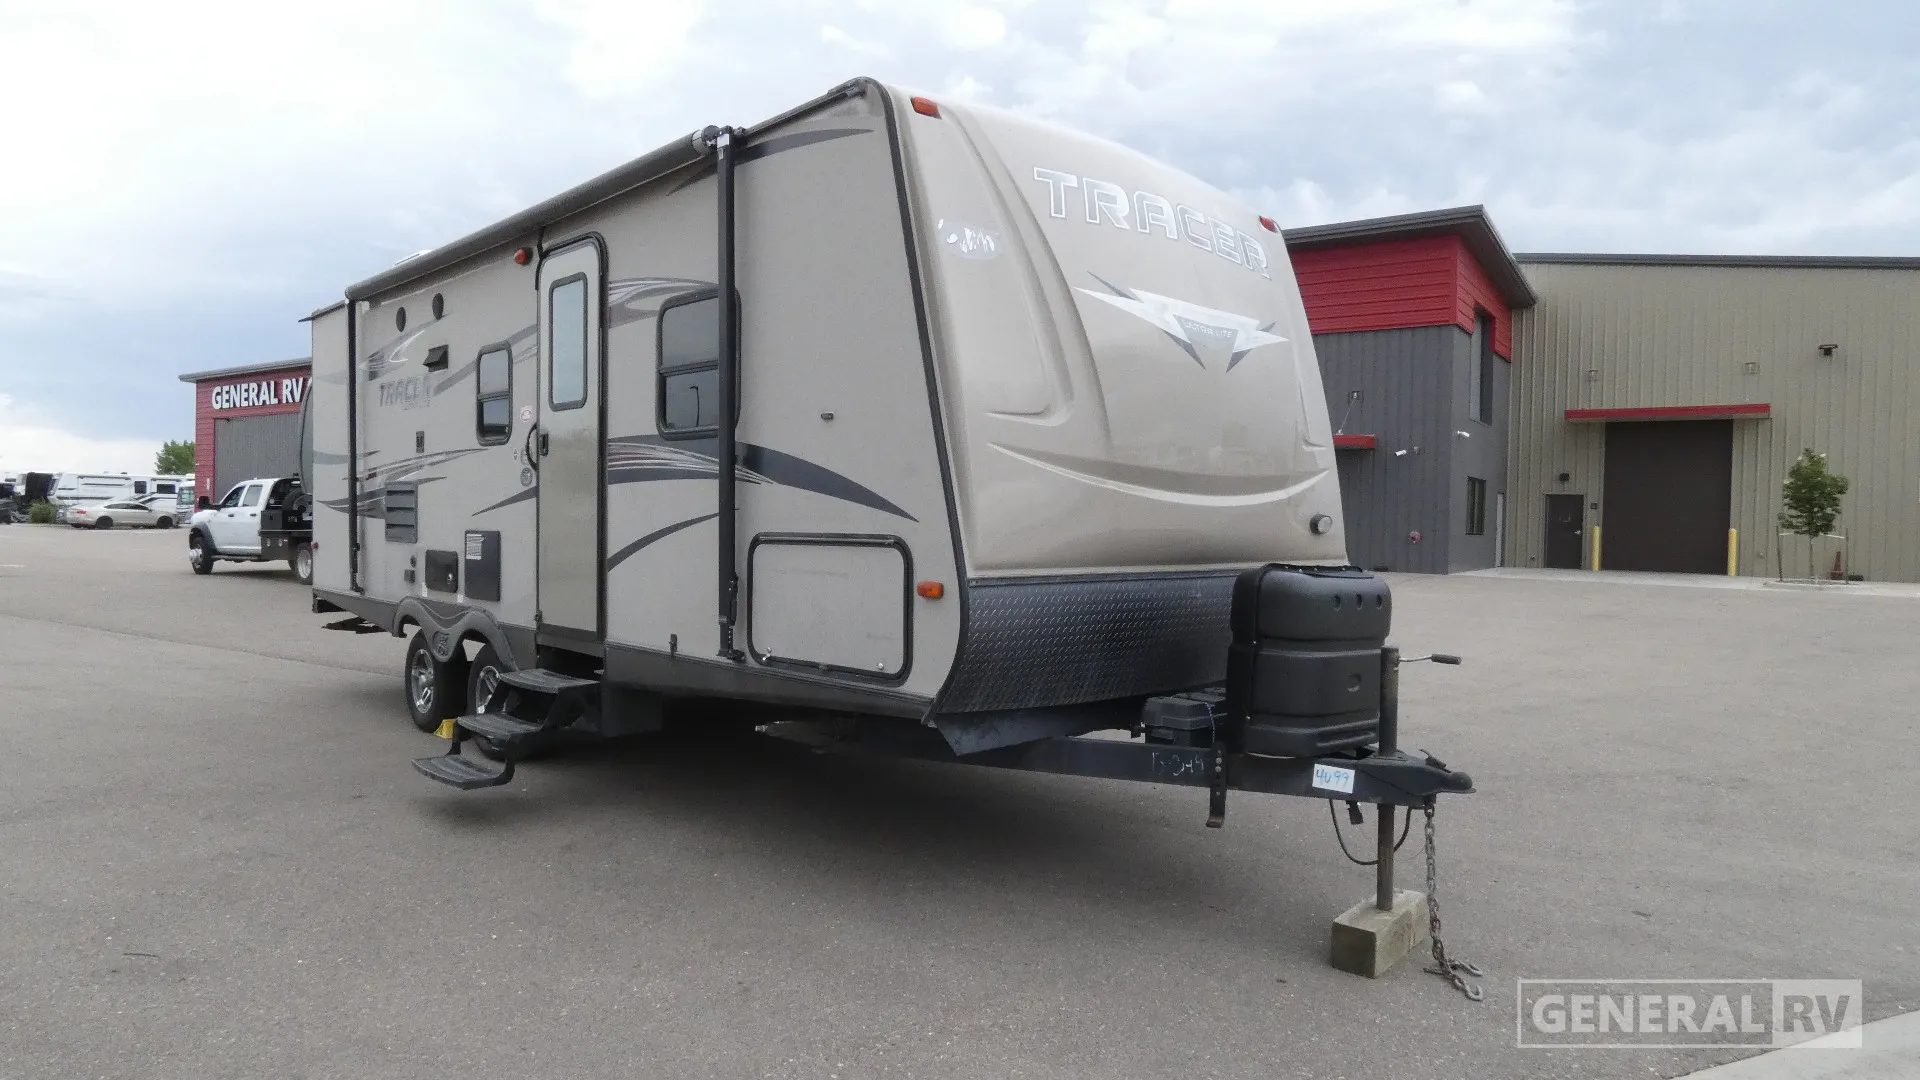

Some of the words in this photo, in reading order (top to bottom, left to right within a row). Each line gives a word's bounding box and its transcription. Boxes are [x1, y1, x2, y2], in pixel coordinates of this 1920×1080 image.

[1033, 166, 1272, 281] TRACER
[212, 380, 278, 410] GENERAL
[282, 377, 303, 404] RV
